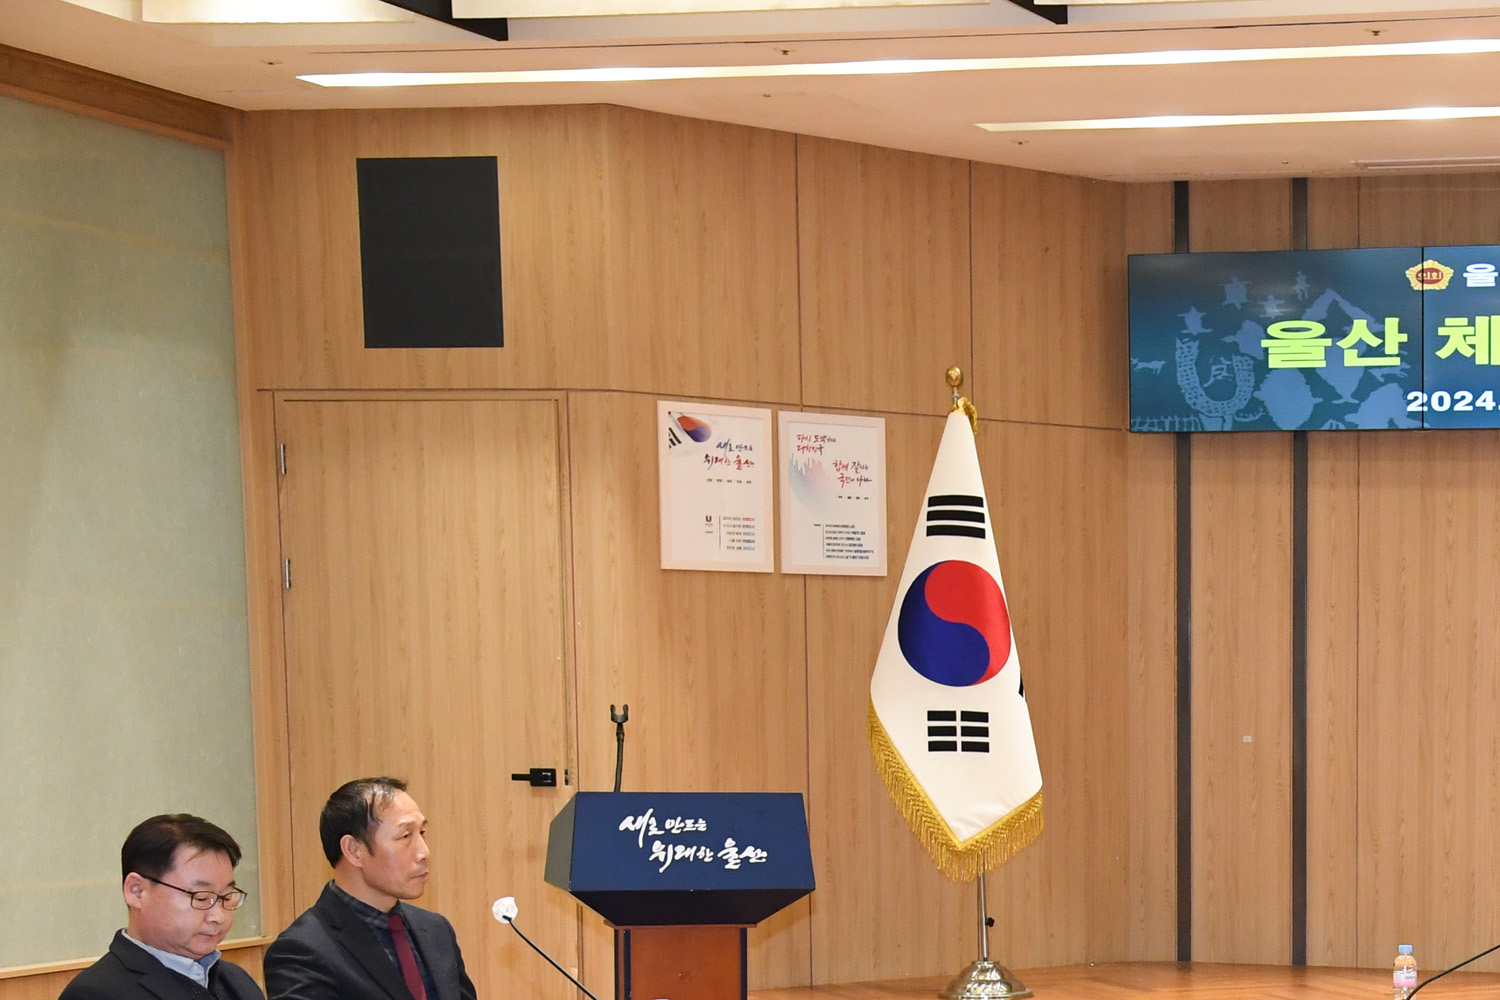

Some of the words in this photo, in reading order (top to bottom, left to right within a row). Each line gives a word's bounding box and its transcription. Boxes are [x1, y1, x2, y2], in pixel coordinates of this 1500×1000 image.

[1260, 317, 1408, 369] 울산
[618, 808, 665, 849] 새로
[664, 816, 708, 834] 만드는
[648, 840, 715, 874] 위대한
[717, 837, 768, 870] 울산
